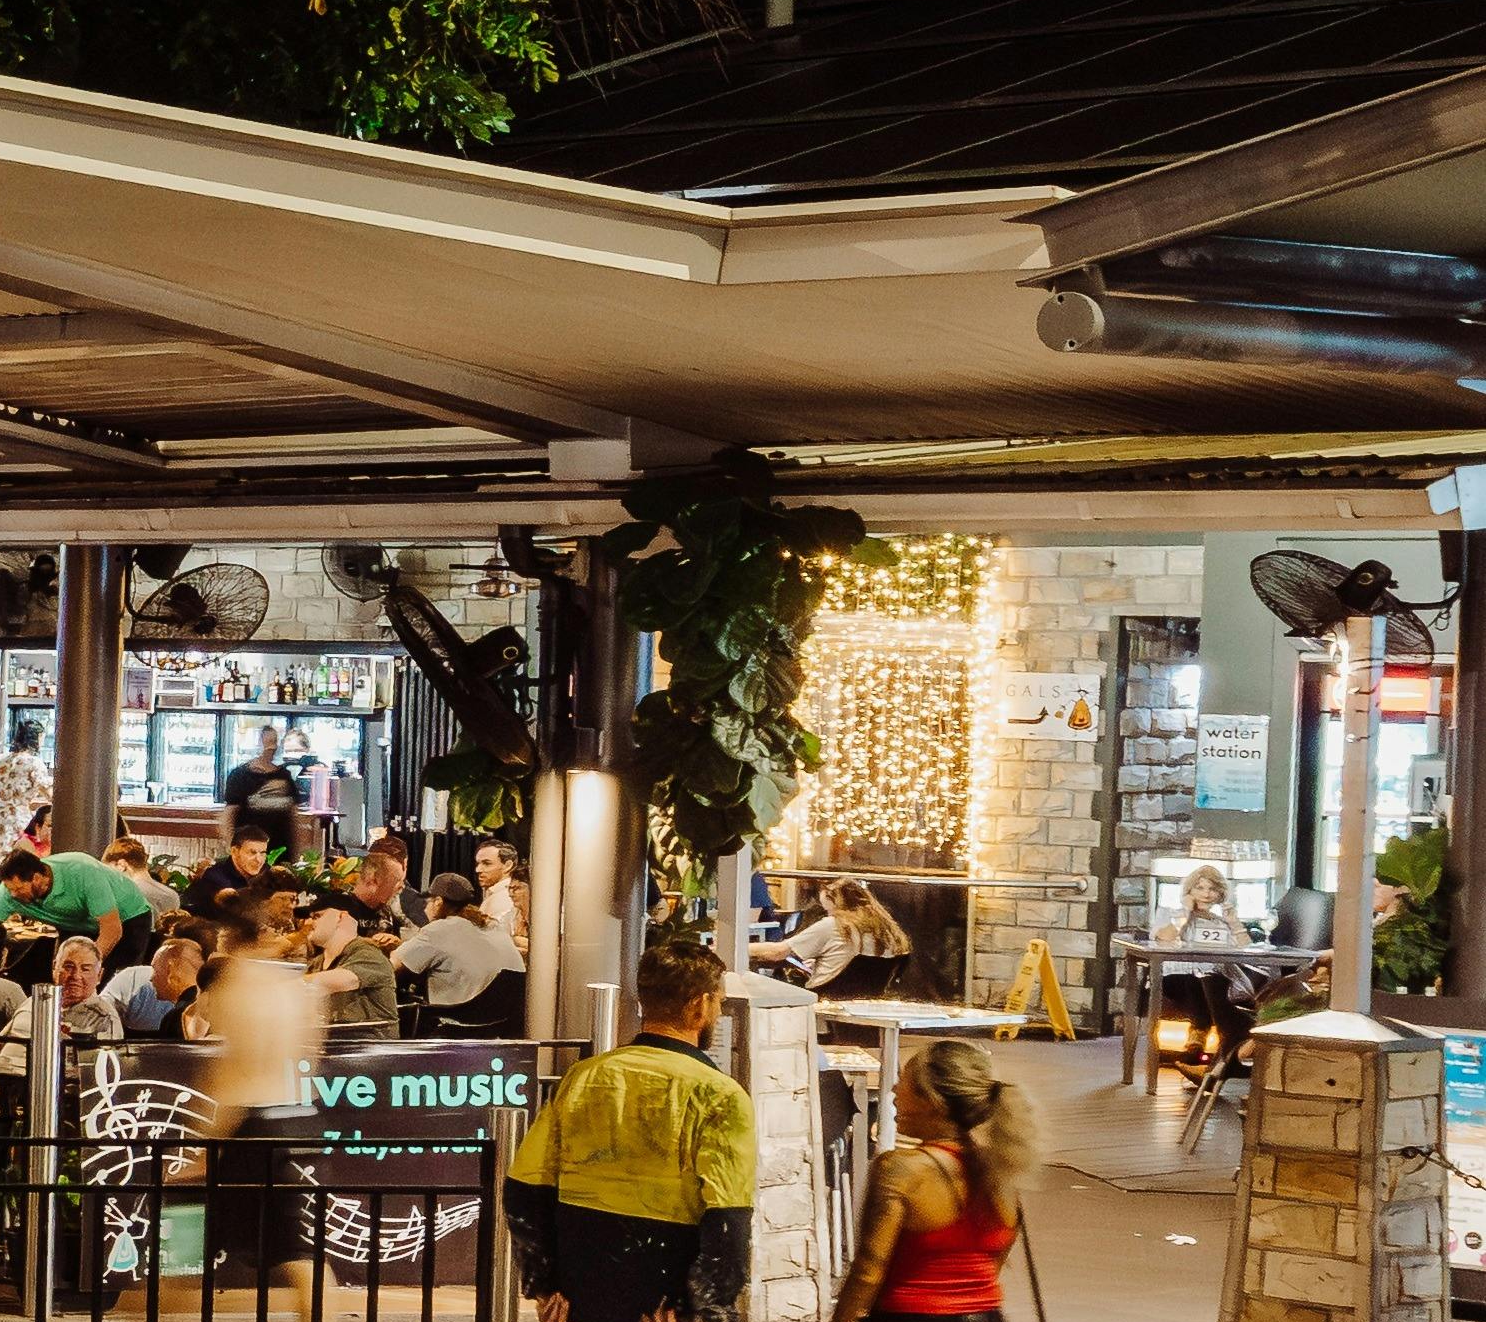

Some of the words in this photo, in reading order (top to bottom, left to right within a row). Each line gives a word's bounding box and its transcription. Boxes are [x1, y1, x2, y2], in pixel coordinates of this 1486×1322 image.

[1006, 685, 1062, 699] GALS
[1206, 726, 1260, 740] water
[1202, 744, 1262, 759] station
[1202, 930, 1221, 942] 92
[391, 1058, 529, 1108] music
